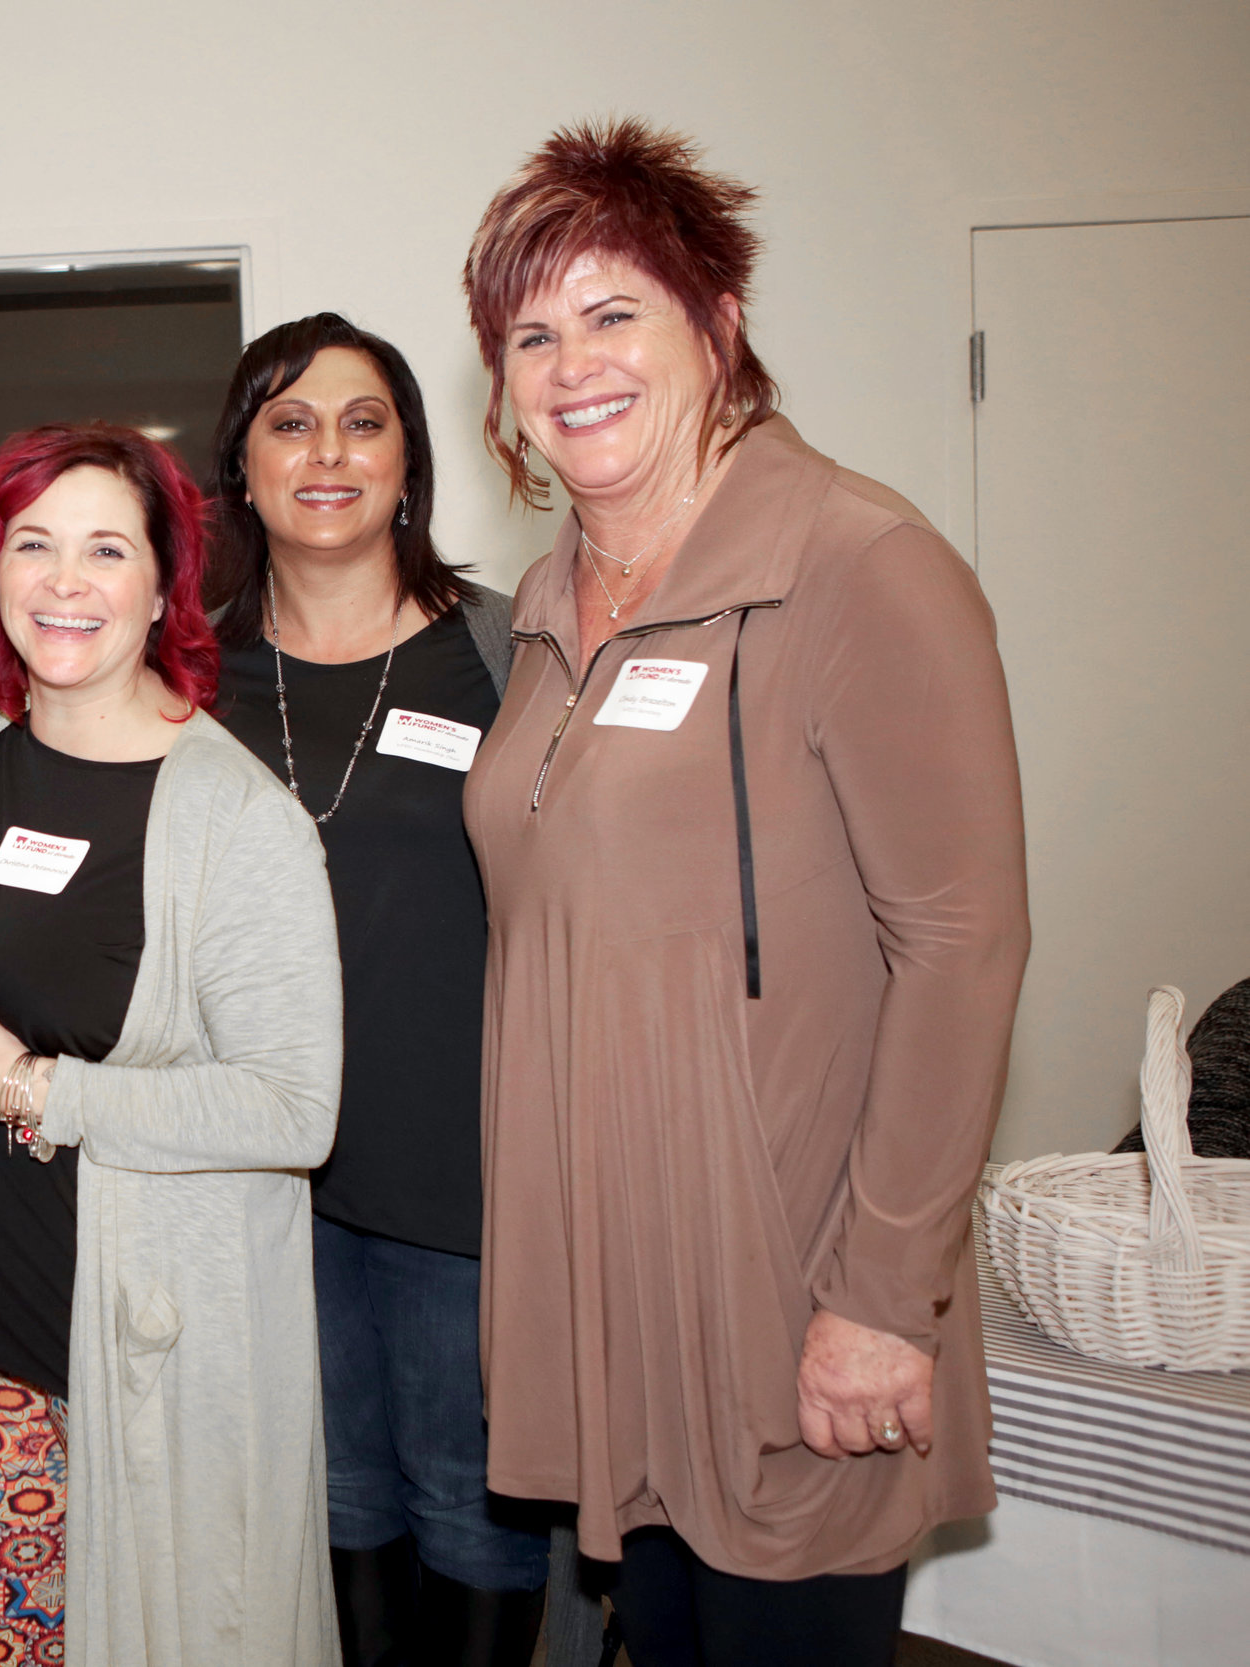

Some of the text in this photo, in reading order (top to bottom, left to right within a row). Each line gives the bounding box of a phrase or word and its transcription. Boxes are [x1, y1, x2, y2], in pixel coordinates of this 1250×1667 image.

[642, 666, 682, 676] WOMEN'S
[412, 722, 437, 732] FUND
[414, 718, 457, 732] WOMEN'S
[26, 845, 48, 854] FUND
[30, 839, 67, 852] WOMEN'S
